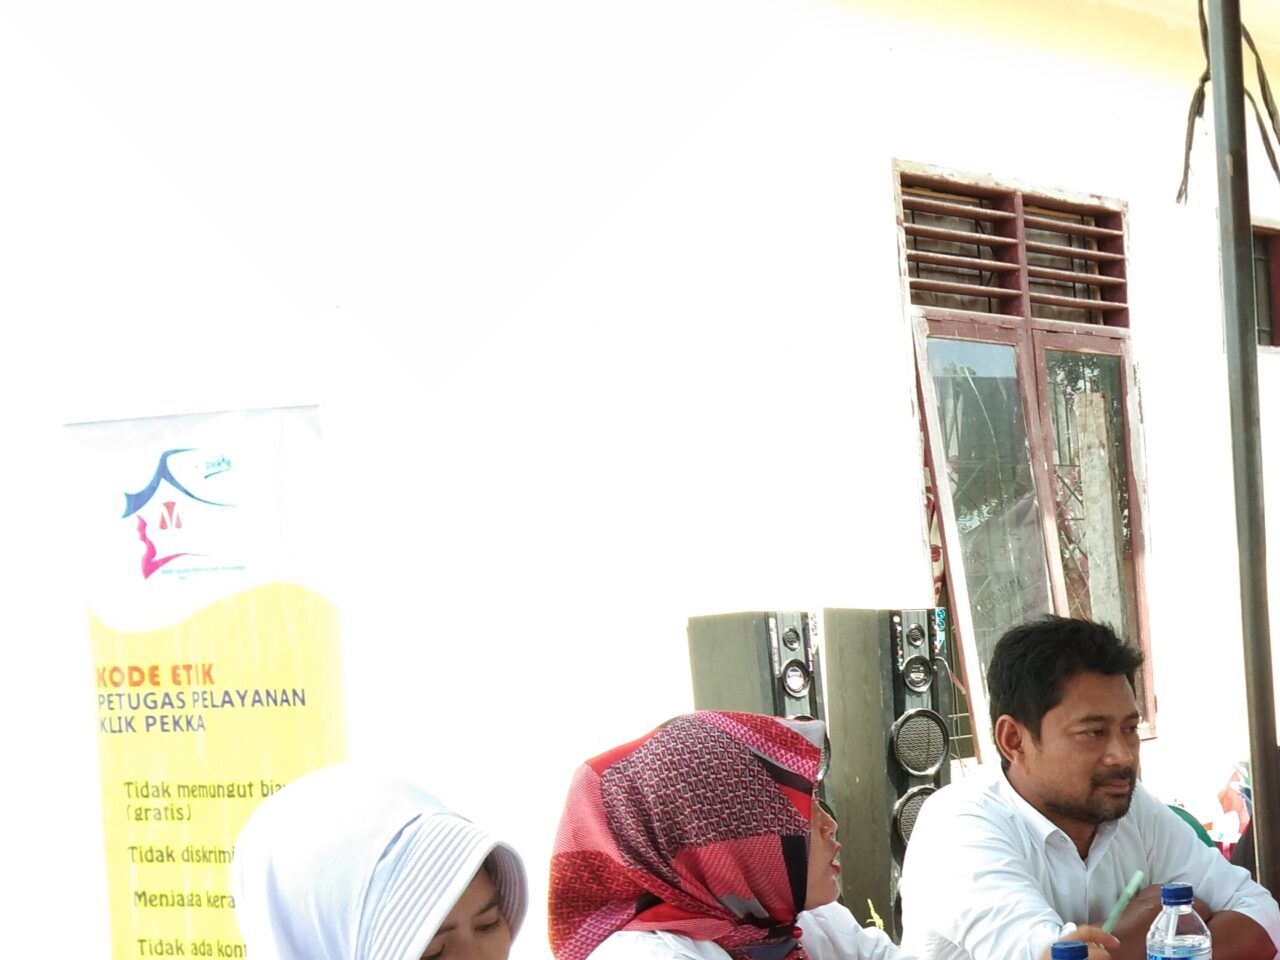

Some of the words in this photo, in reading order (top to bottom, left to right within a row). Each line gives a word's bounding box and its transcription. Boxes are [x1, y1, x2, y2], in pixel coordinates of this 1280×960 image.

[97, 665, 161, 688] KODE
[170, 663, 215, 686] ETIK
[98, 691, 186, 711] PETUGAS
[191, 688, 307, 709] PELAYANAN
[99, 715, 137, 734] KLIK
[145, 713, 206, 733] PEKKA
[123, 782, 171, 799] Tidak
[177, 782, 254, 799] memungut
[126, 803, 193, 821] (gratis)
[128, 846, 175, 863] Tidak
[134, 890, 203, 908] Menjaga
[137, 938, 185, 957] Tidak
[190, 940, 213, 957] ada
